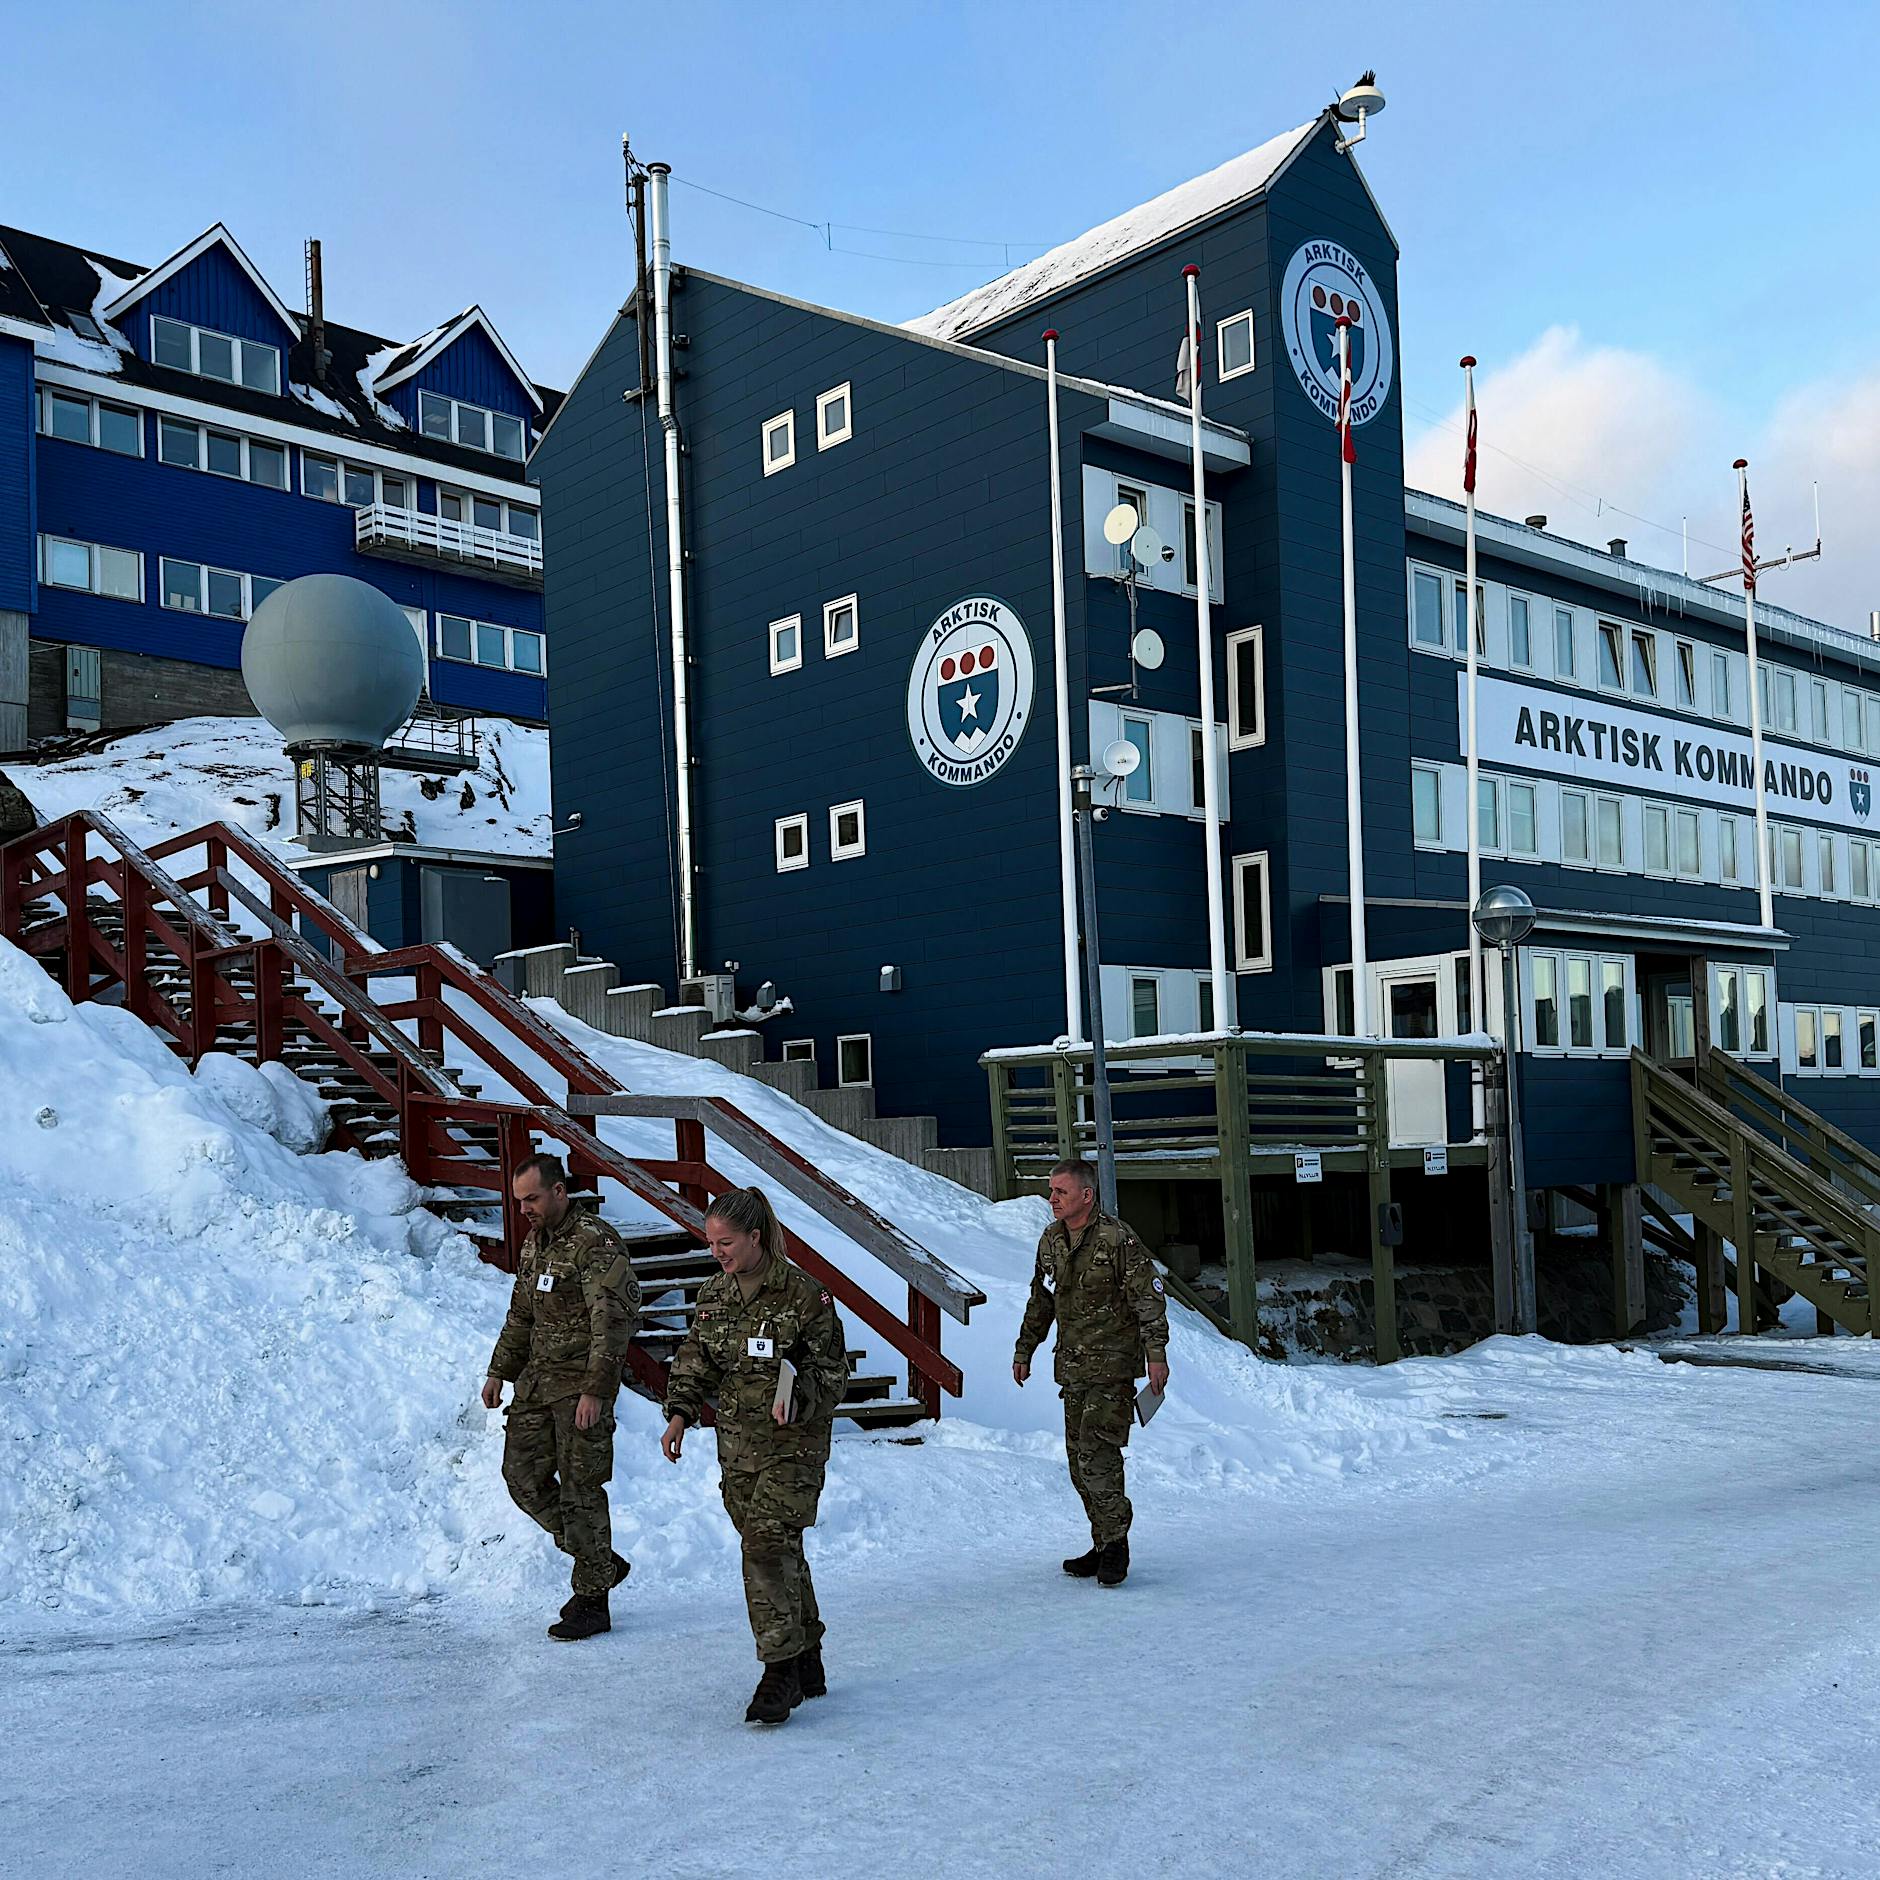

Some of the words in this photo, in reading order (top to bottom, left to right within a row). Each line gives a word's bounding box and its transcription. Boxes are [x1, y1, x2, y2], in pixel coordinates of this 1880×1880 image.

[1304, 243, 1366, 285] ARKTISK
[1300, 369, 1377, 423] KOMNDO
[932, 602, 1001, 645] ARKTISK
[927, 733, 1014, 783] KOMMANDO
[1514, 706, 1664, 772] ARKTISK
[1674, 739, 1833, 805] KOMMANDO
